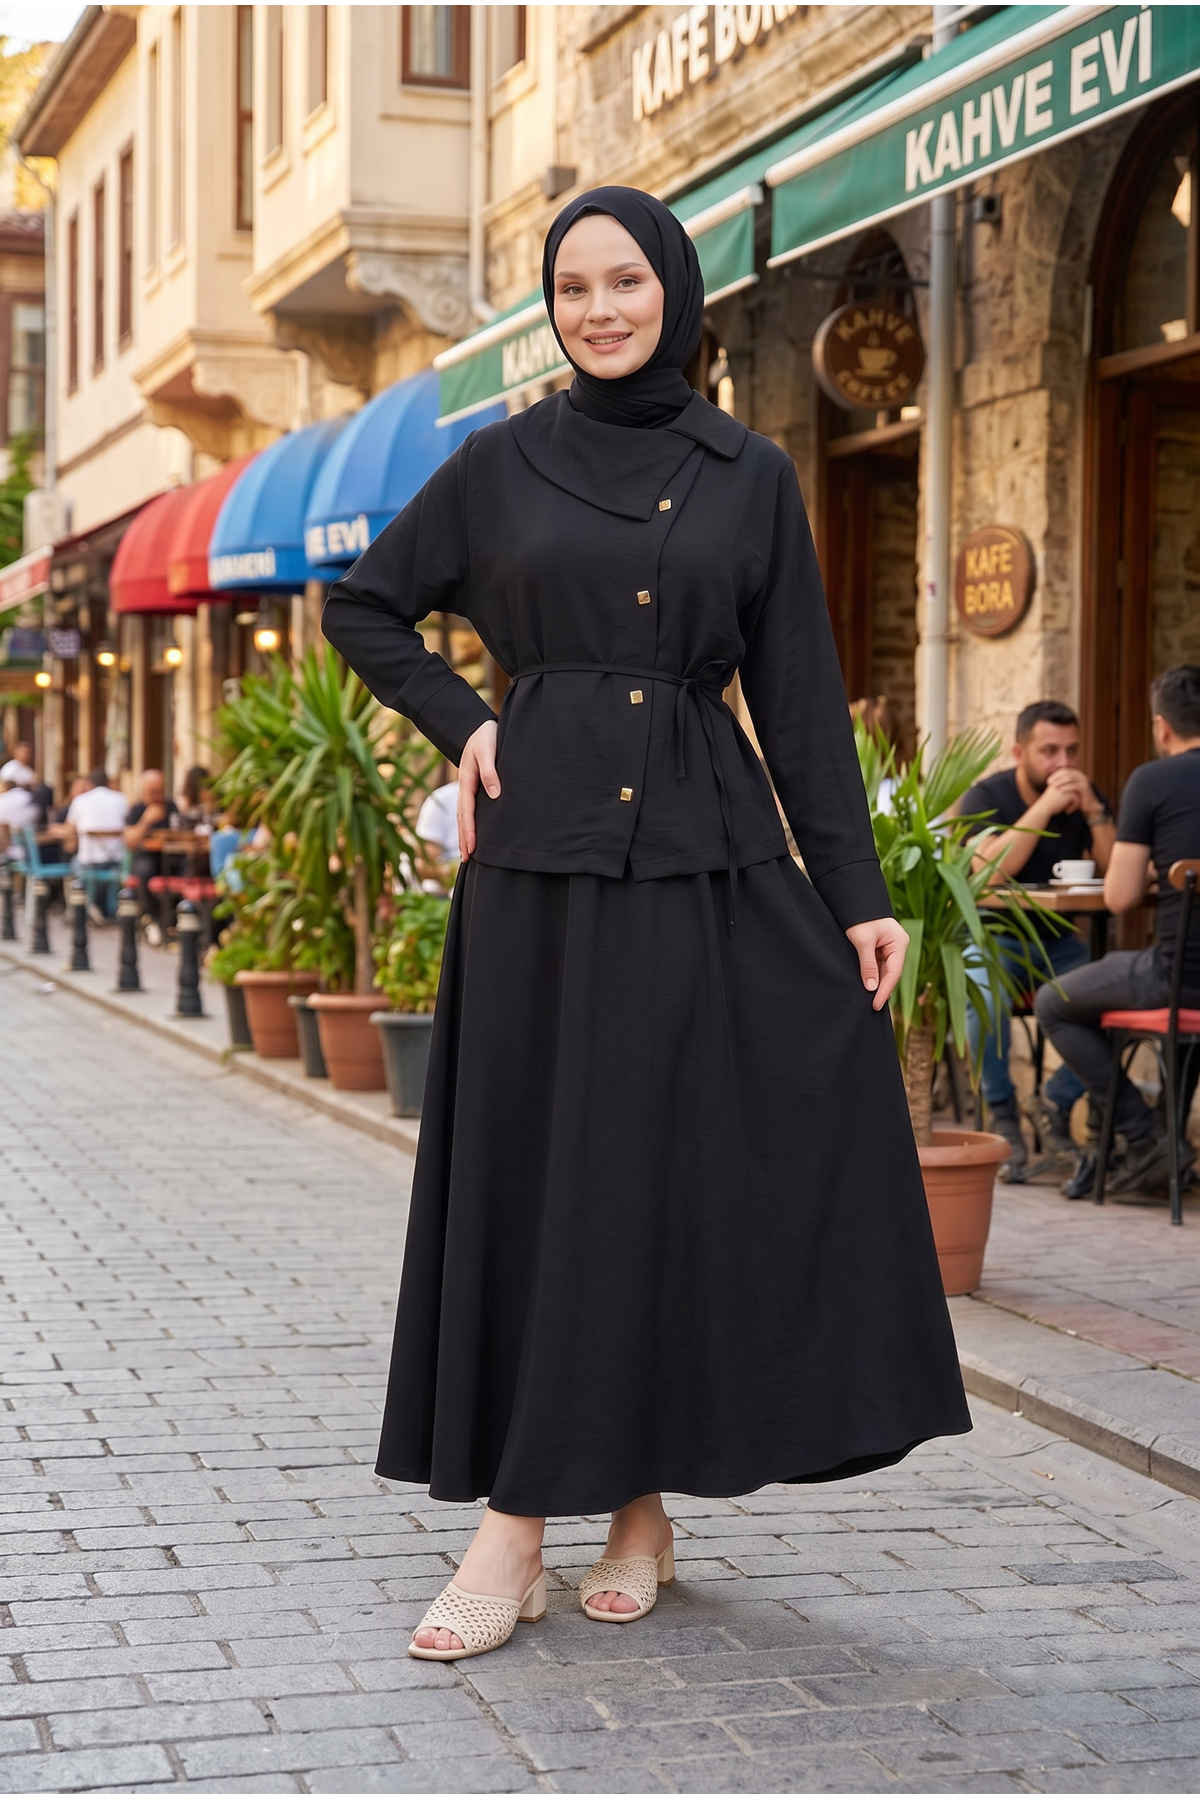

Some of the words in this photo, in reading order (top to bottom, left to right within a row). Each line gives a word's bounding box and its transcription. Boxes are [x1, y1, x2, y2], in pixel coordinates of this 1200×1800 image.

[632, 5, 710, 122] KAFE
[905, 59, 1053, 193] KAHVE
[1069, 5, 1152, 116] EVİ
[835, 307, 916, 345] KAHVE
[502, 324, 566, 388] KAHV
[326, 514, 370, 555] EVİ
[965, 541, 1013, 580] KAFE
[964, 579, 1015, 616] BORA
